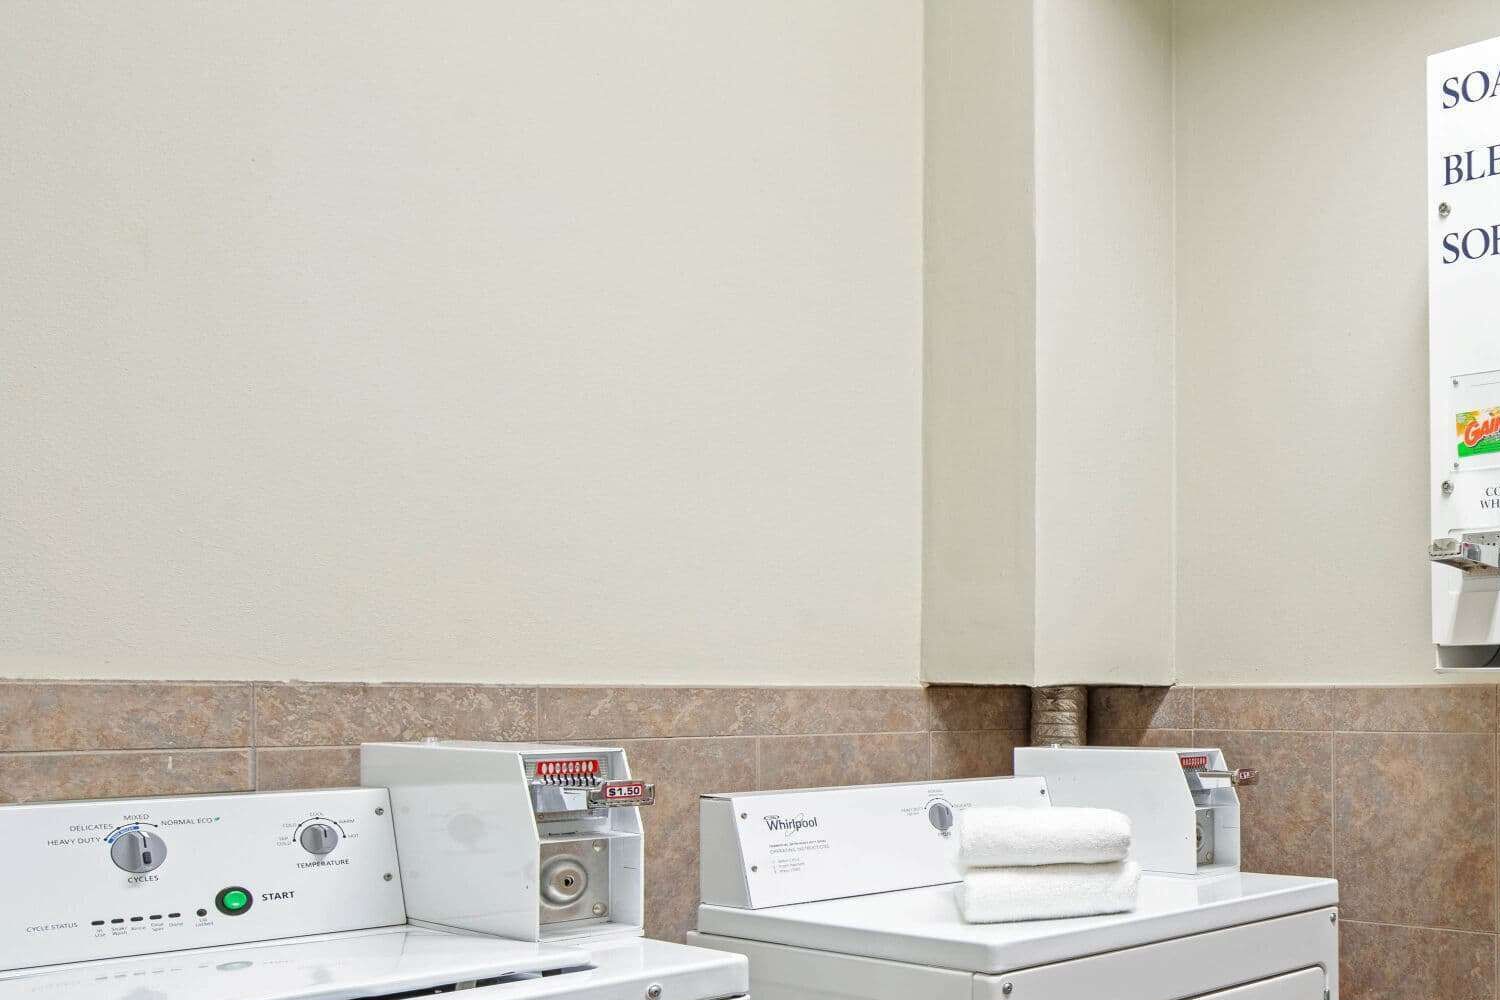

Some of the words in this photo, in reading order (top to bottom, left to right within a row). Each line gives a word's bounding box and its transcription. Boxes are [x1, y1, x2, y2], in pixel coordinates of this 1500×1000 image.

[608, 786, 640, 797] $1.50
[123, 813, 150, 821] MIXED
[69, 823, 113, 832] DELICATES
[161, 819, 196, 827] NORMAL
[766, 816, 818, 831] Whirlpool
[47, 838, 76, 846] HEAVY
[77, 836, 101, 844] DUTY
[296, 859, 350, 869] TEMPERATURE
[127, 875, 159, 884] CYCLES
[261, 890, 295, 901] START
[26, 924, 49, 933] CYCLE
[50, 921, 79, 931] STATUS
